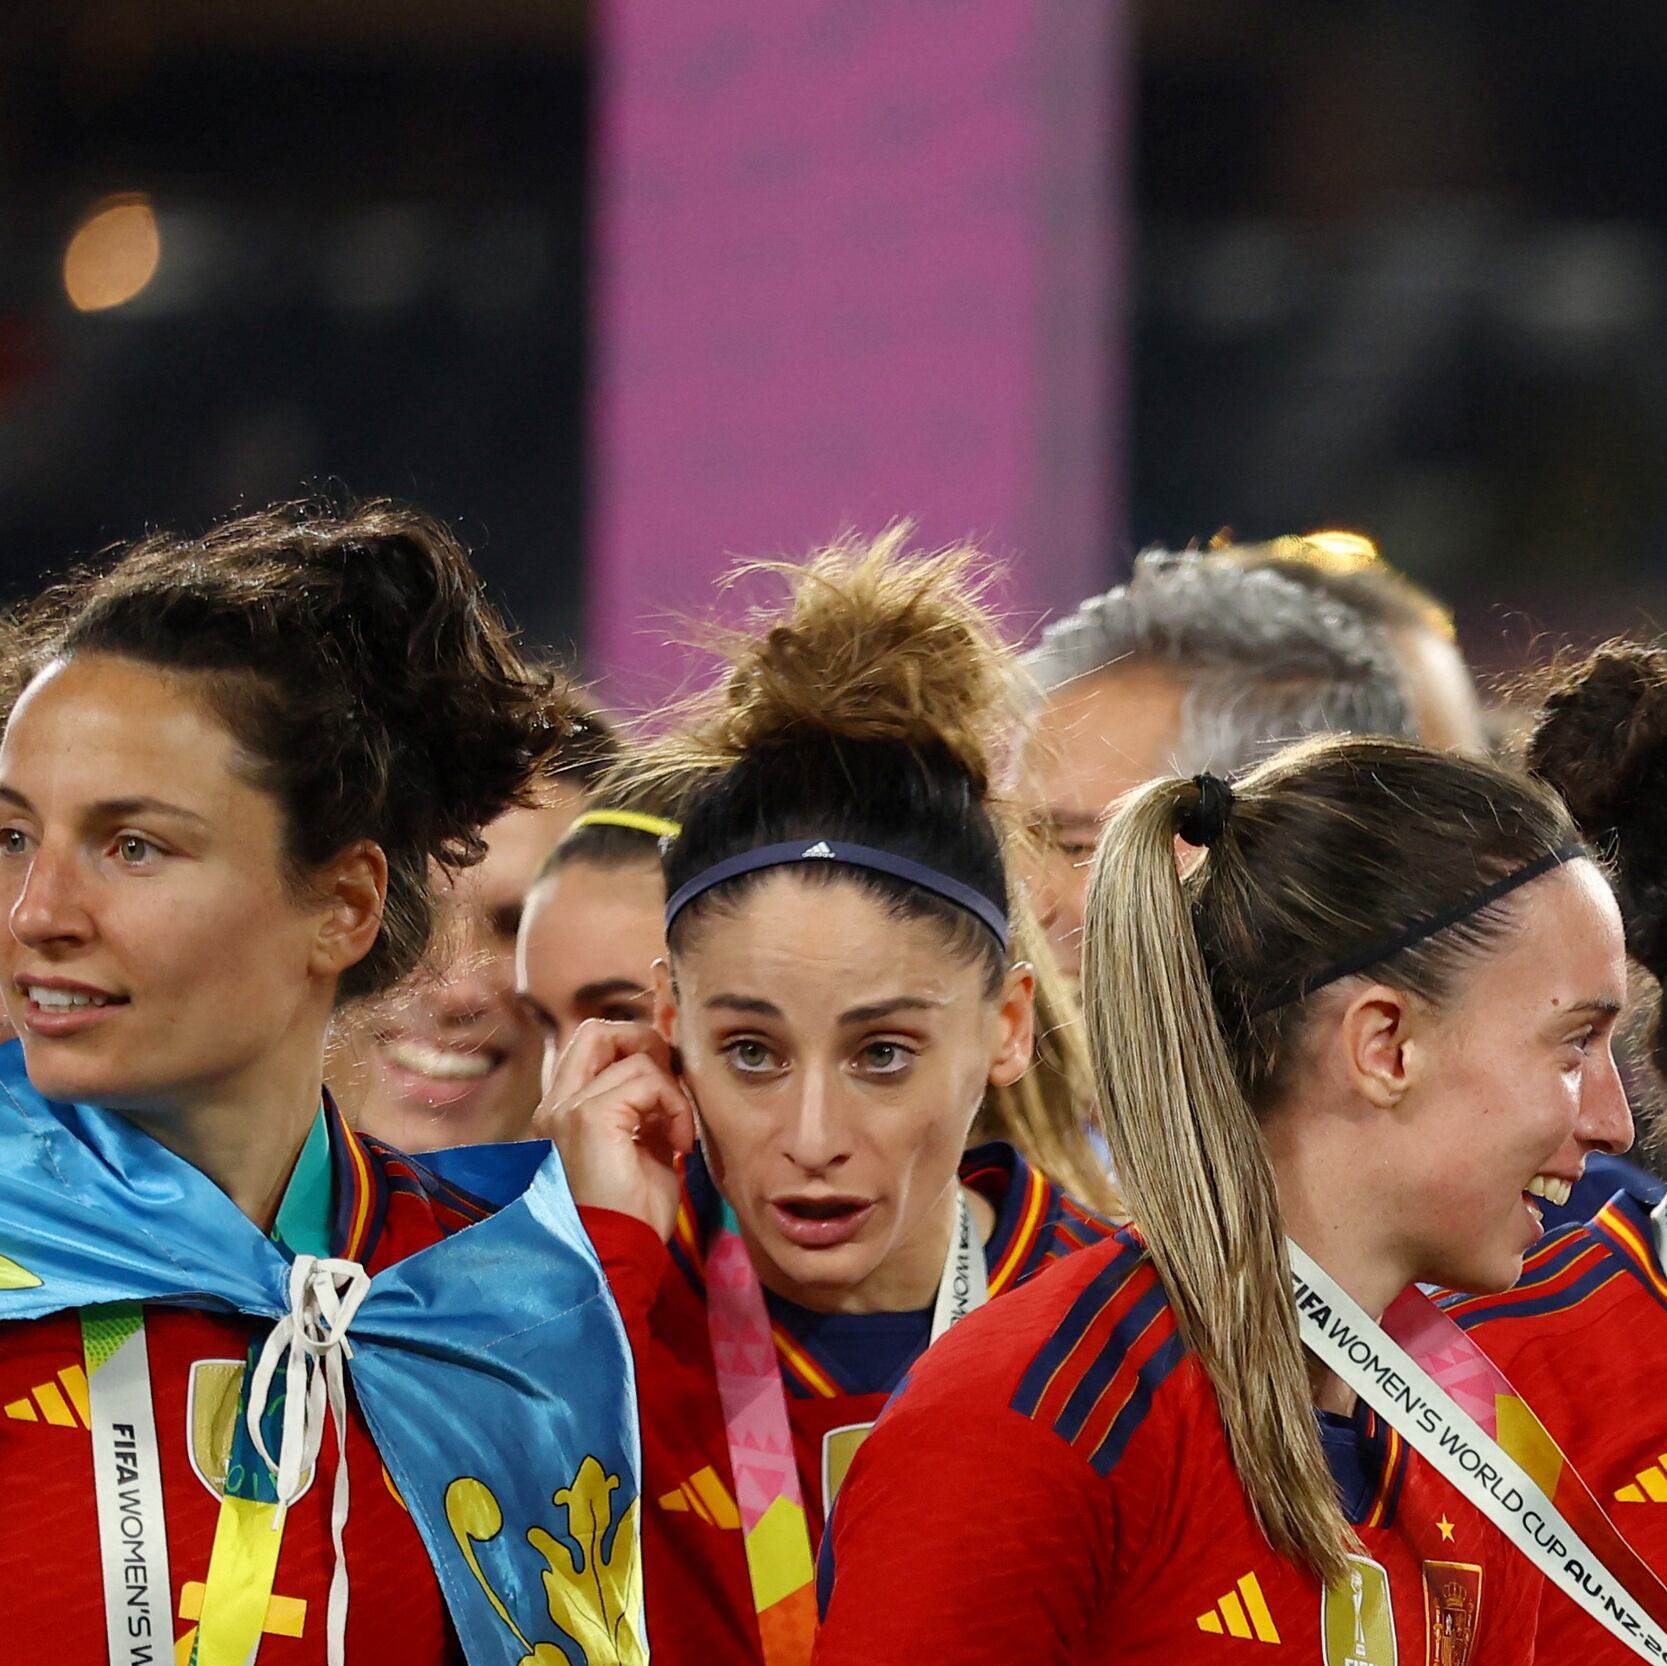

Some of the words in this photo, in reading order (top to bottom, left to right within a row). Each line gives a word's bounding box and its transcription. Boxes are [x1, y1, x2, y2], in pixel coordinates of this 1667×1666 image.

[112, 1422, 139, 1486] FIFA
[1329, 1317, 1443, 1434] WOMEN'S
[1439, 1426, 1524, 1513] WORLD
[1522, 1511, 1567, 1558] CUP
[118, 1488, 153, 1638] WOMEN'S
